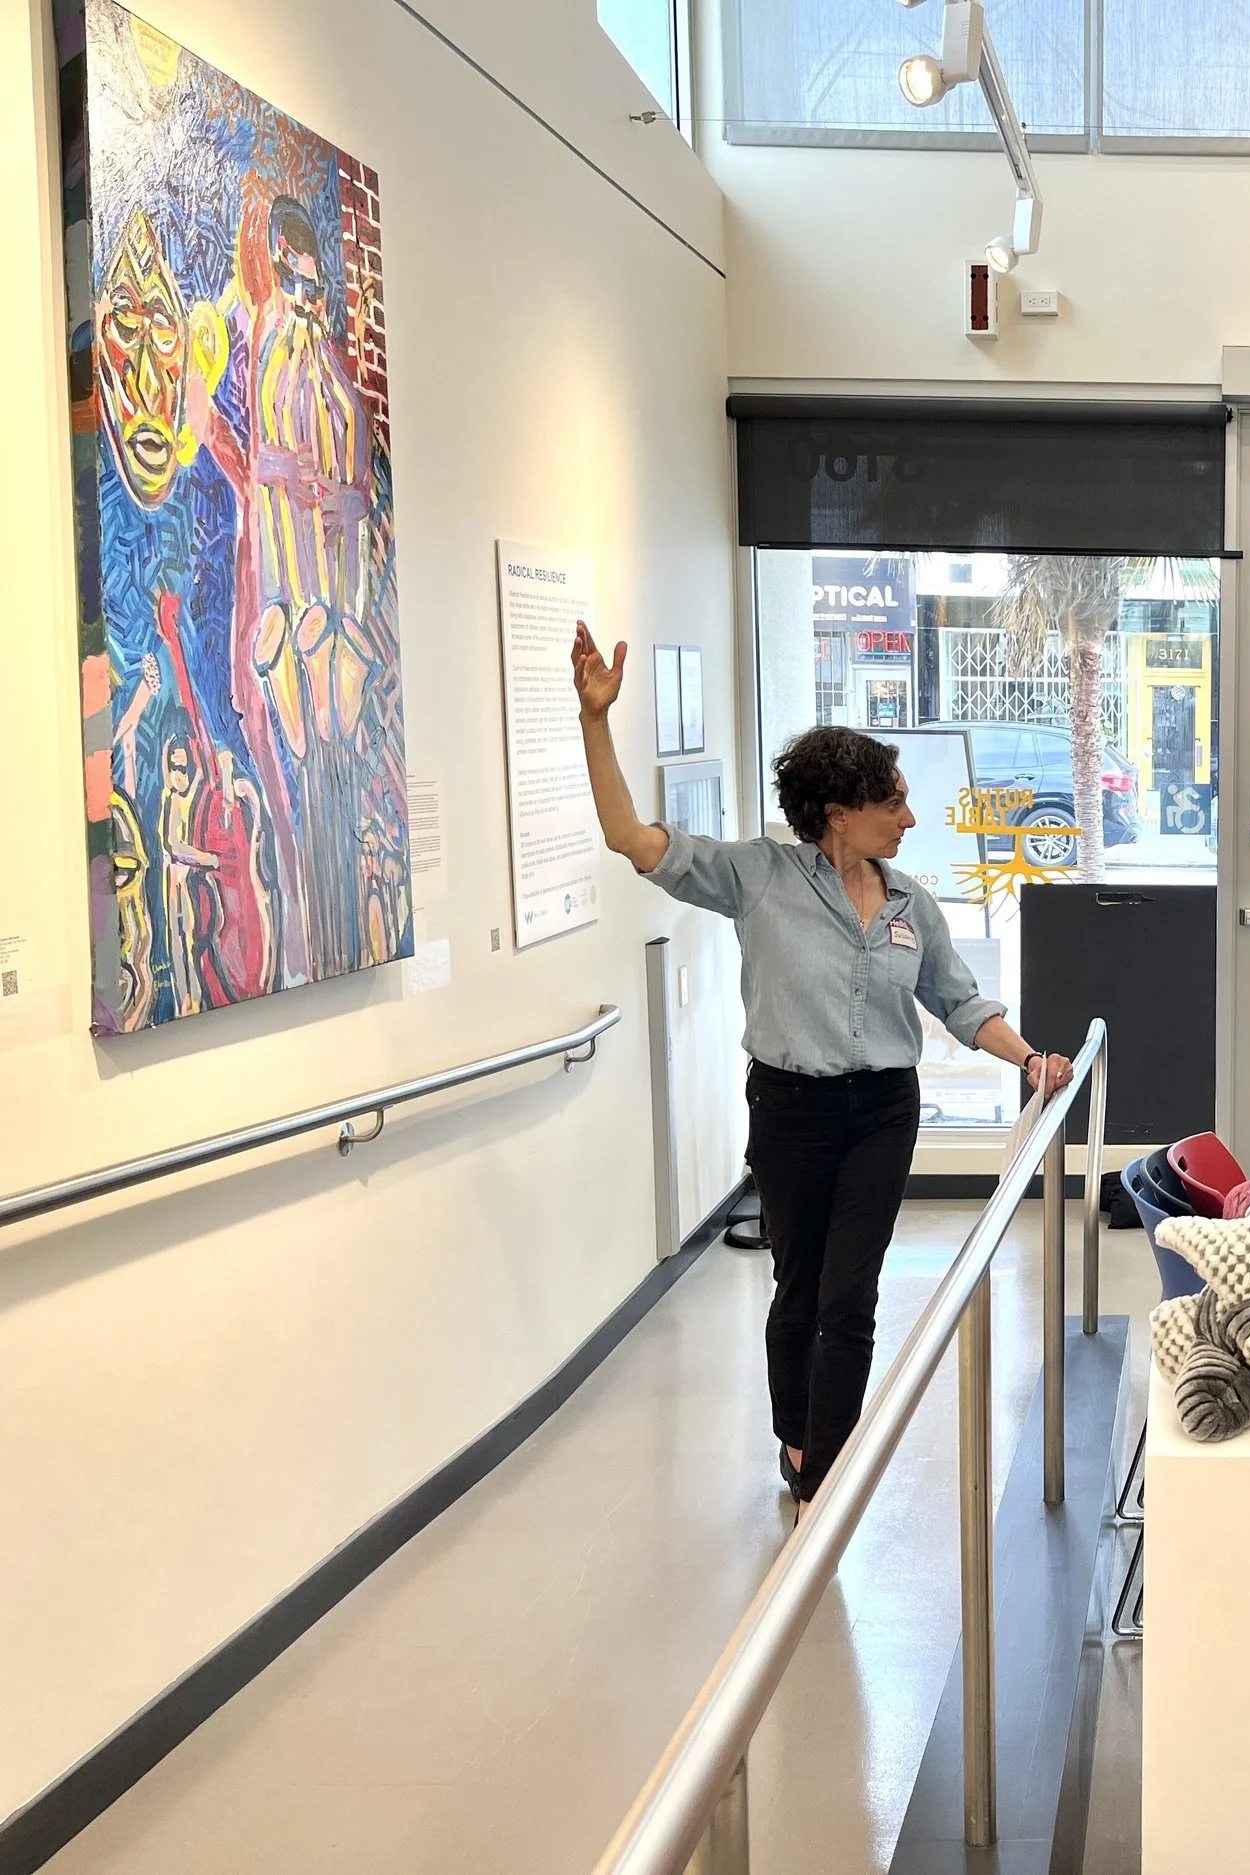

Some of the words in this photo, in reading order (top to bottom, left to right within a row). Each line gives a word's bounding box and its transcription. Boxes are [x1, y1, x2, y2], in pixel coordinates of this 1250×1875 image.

[507, 563, 535, 580] RADICAL
[535, 568, 567, 584] RESILIENCE
[857, 630, 911, 653] OPEN
[1158, 648, 1189, 660] 3171
